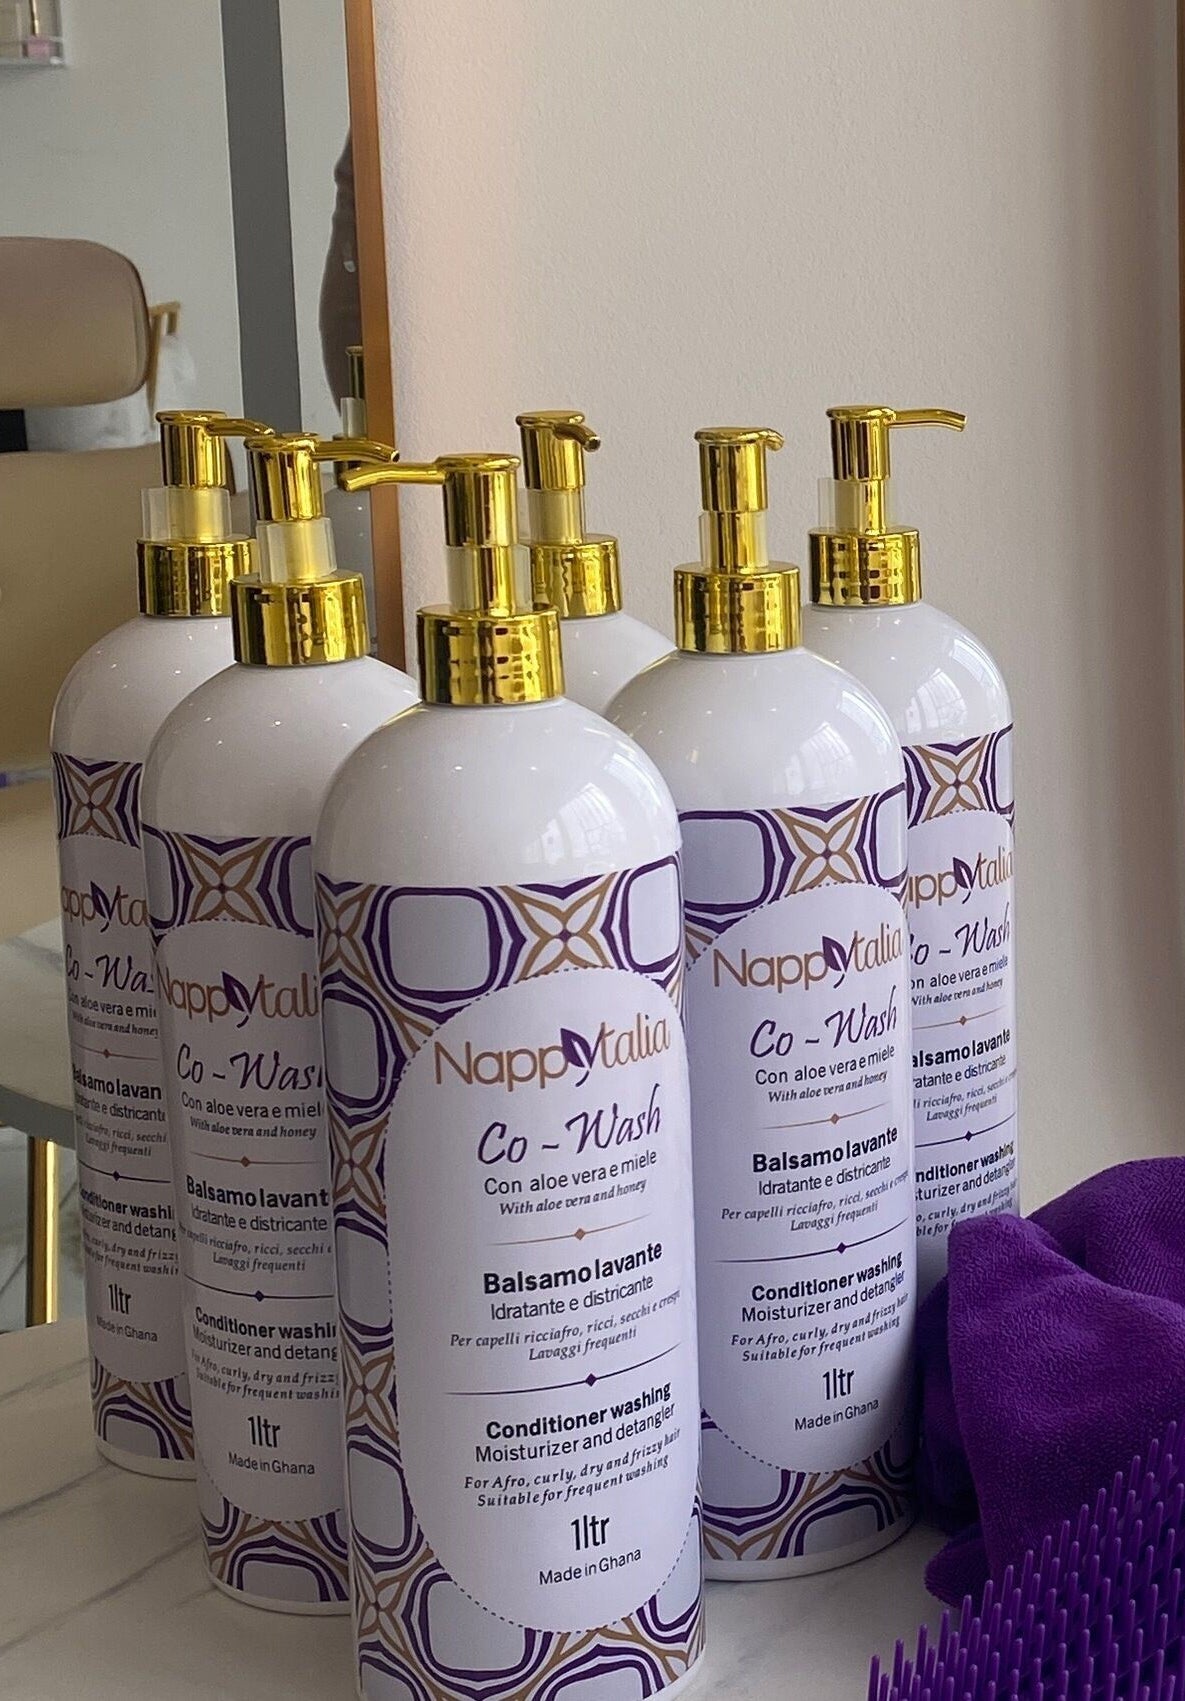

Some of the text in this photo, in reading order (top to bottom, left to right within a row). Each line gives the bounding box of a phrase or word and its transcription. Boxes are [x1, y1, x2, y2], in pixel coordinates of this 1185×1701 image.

[955, 902, 1009, 957] Wash
[66, 944, 79, 980] Co
[930, 973, 956, 987] aloe
[959, 967, 980, 981] vera
[101, 1003, 133, 1016] vera e
[157, 963, 318, 1028] Nappytali
[934, 993, 952, 1003] aloe
[750, 985, 897, 1058] Co Wash
[177, 1043, 203, 1084] Co
[755, 1045, 894, 1085] Con aloe vera e miele
[913, 1029, 1010, 1068] alsamo lavante
[955, 1071, 961, 1081] e
[964, 1055, 1006, 1079] districante
[117, 1079, 162, 1099] lavan
[769, 1071, 887, 1102] With aloe vera and honey
[182, 1091, 320, 1118] Con aloe vera e miel
[232, 1124, 253, 1137] vera
[256, 1126, 277, 1137] and
[280, 1125, 316, 1140] honey
[477, 1084, 660, 1164] Co Wash
[753, 1127, 897, 1173] Balsamo lavante
[484, 1151, 656, 1195] Con aloe vera e miele
[759, 1156, 890, 1195] Idratante e districante
[916, 1158, 978, 1183] nditioner
[962, 1174, 982, 1192] and
[186, 1175, 329, 1208] Balsamo lavant
[500, 1180, 646, 1215] With aloe vera and honey
[961, 1200, 975, 1213] dry
[112, 1222, 132, 1234] and
[191, 1202, 235, 1229] Idratante
[239, 1218, 246, 1229] e
[250, 1216, 328, 1232] districante
[722, 1208, 740, 1220] Per
[744, 1206, 782, 1220] capelli
[791, 1202, 878, 1231] Lavaggi frequenti
[933, 1222, 949, 1236] for
[252, 1258, 305, 1273] frequenti
[287, 1243, 323, 1255] secchi
[484, 1242, 662, 1294] Balsamo lavante
[752, 1251, 902, 1301] Conditioner washing
[491, 1275, 653, 1320] Idratante e districante
[742, 1270, 905, 1322] Moisturizer and detangler
[125, 1325, 157, 1341] Ghana
[196, 1306, 336, 1339] Conditioner washi
[450, 1334, 472, 1346] Per
[476, 1330, 519, 1347] capelli
[588, 1315, 616, 1334] ricci,
[620, 1303, 650, 1325] secchi
[731, 1303, 895, 1347] For Afro, curly, dry and frizzy
[743, 1316, 899, 1362] Suitable for frequent washing
[193, 1324, 281, 1359] Moisturizer and
[529, 1327, 636, 1360] Lavaggi frequenti
[227, 1382, 340, 1400] for frequent washi
[253, 1370, 273, 1385] dry
[276, 1372, 299, 1383] and
[486, 1382, 671, 1439] Conditioner washing
[795, 1399, 879, 1431] Made in Ghana
[476, 1403, 674, 1462] Moisturizer and detangler
[229, 1452, 315, 1475] Made in Ghana
[464, 1429, 680, 1490] For Afro, curly, dry and frizzy hair
[478, 1453, 668, 1507] Suitable for frequent washing
[539, 1549, 641, 1585] Made in Ghana
